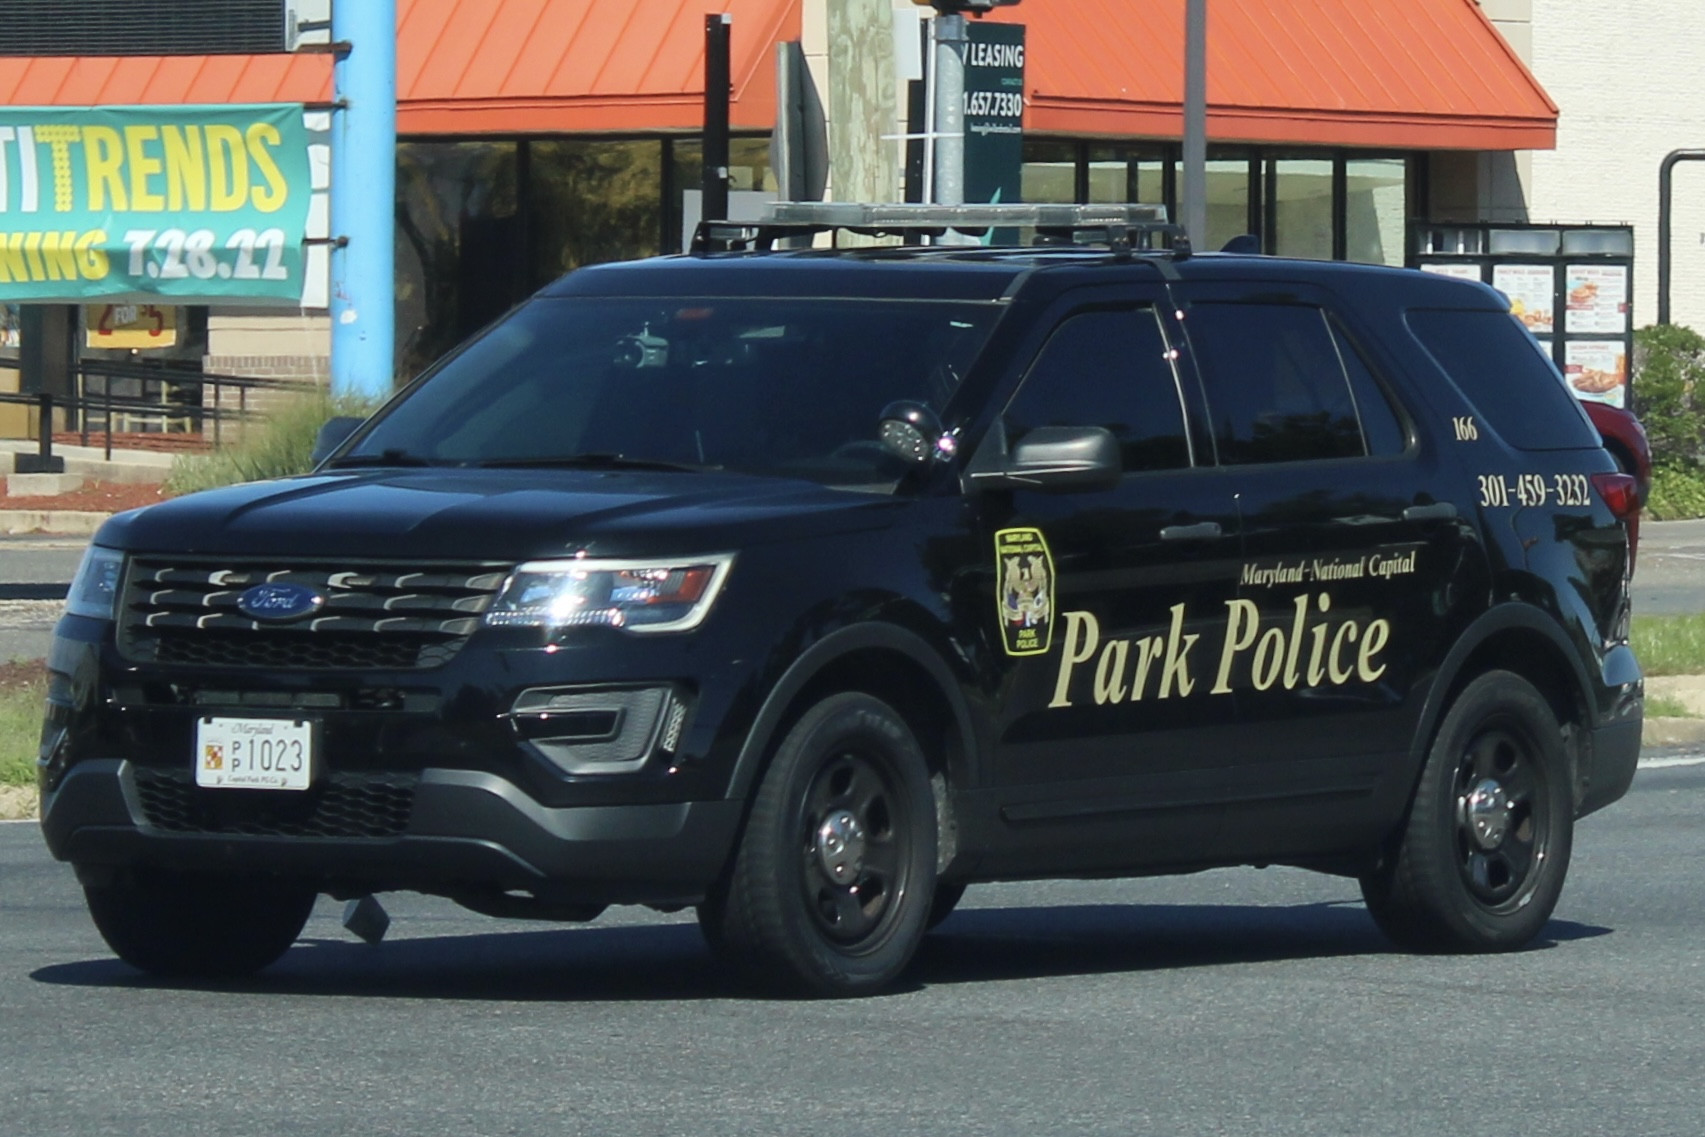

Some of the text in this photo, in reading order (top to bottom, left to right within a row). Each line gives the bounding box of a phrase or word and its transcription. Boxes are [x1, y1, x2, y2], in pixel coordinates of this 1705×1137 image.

[971, 43, 1024, 68] LEASING
[123, 228, 288, 280] 7.28.22
[1452, 416, 1478, 441] 166
[1477, 473, 1591, 507] 301-459-3232
[1239, 550, 1416, 589] Maryland-National Capital
[250, 587, 300, 609] Ford
[1047, 591, 1391, 709] Park Police
[248, 738, 303, 772] 1023
